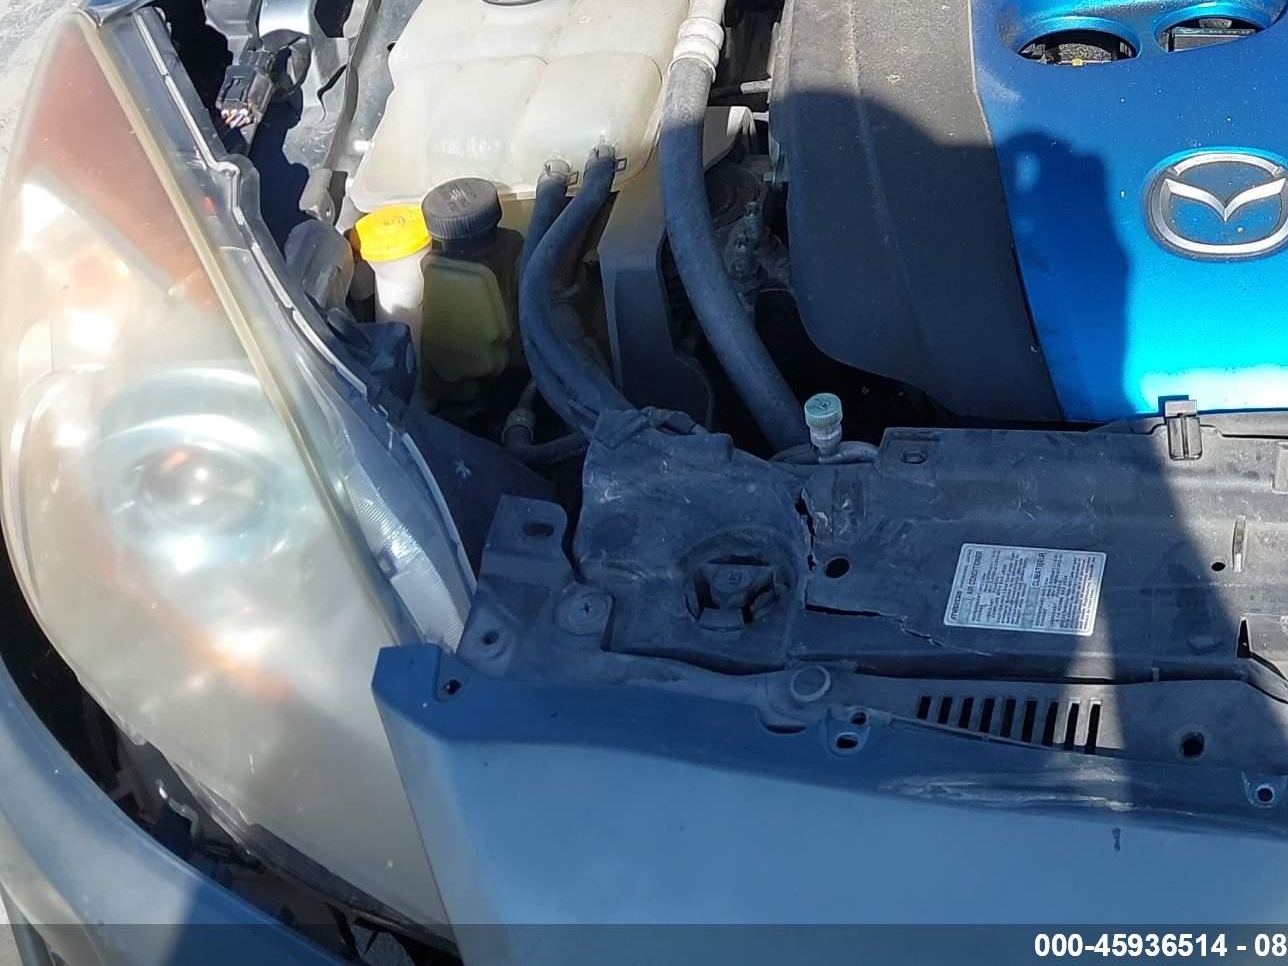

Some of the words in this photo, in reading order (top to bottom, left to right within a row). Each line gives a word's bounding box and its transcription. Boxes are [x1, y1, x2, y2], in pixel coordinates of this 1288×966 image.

[968, 551, 983, 585] CONDITIONER
[966, 585, 975, 595] AIR
[951, 591, 962, 619] mazda
